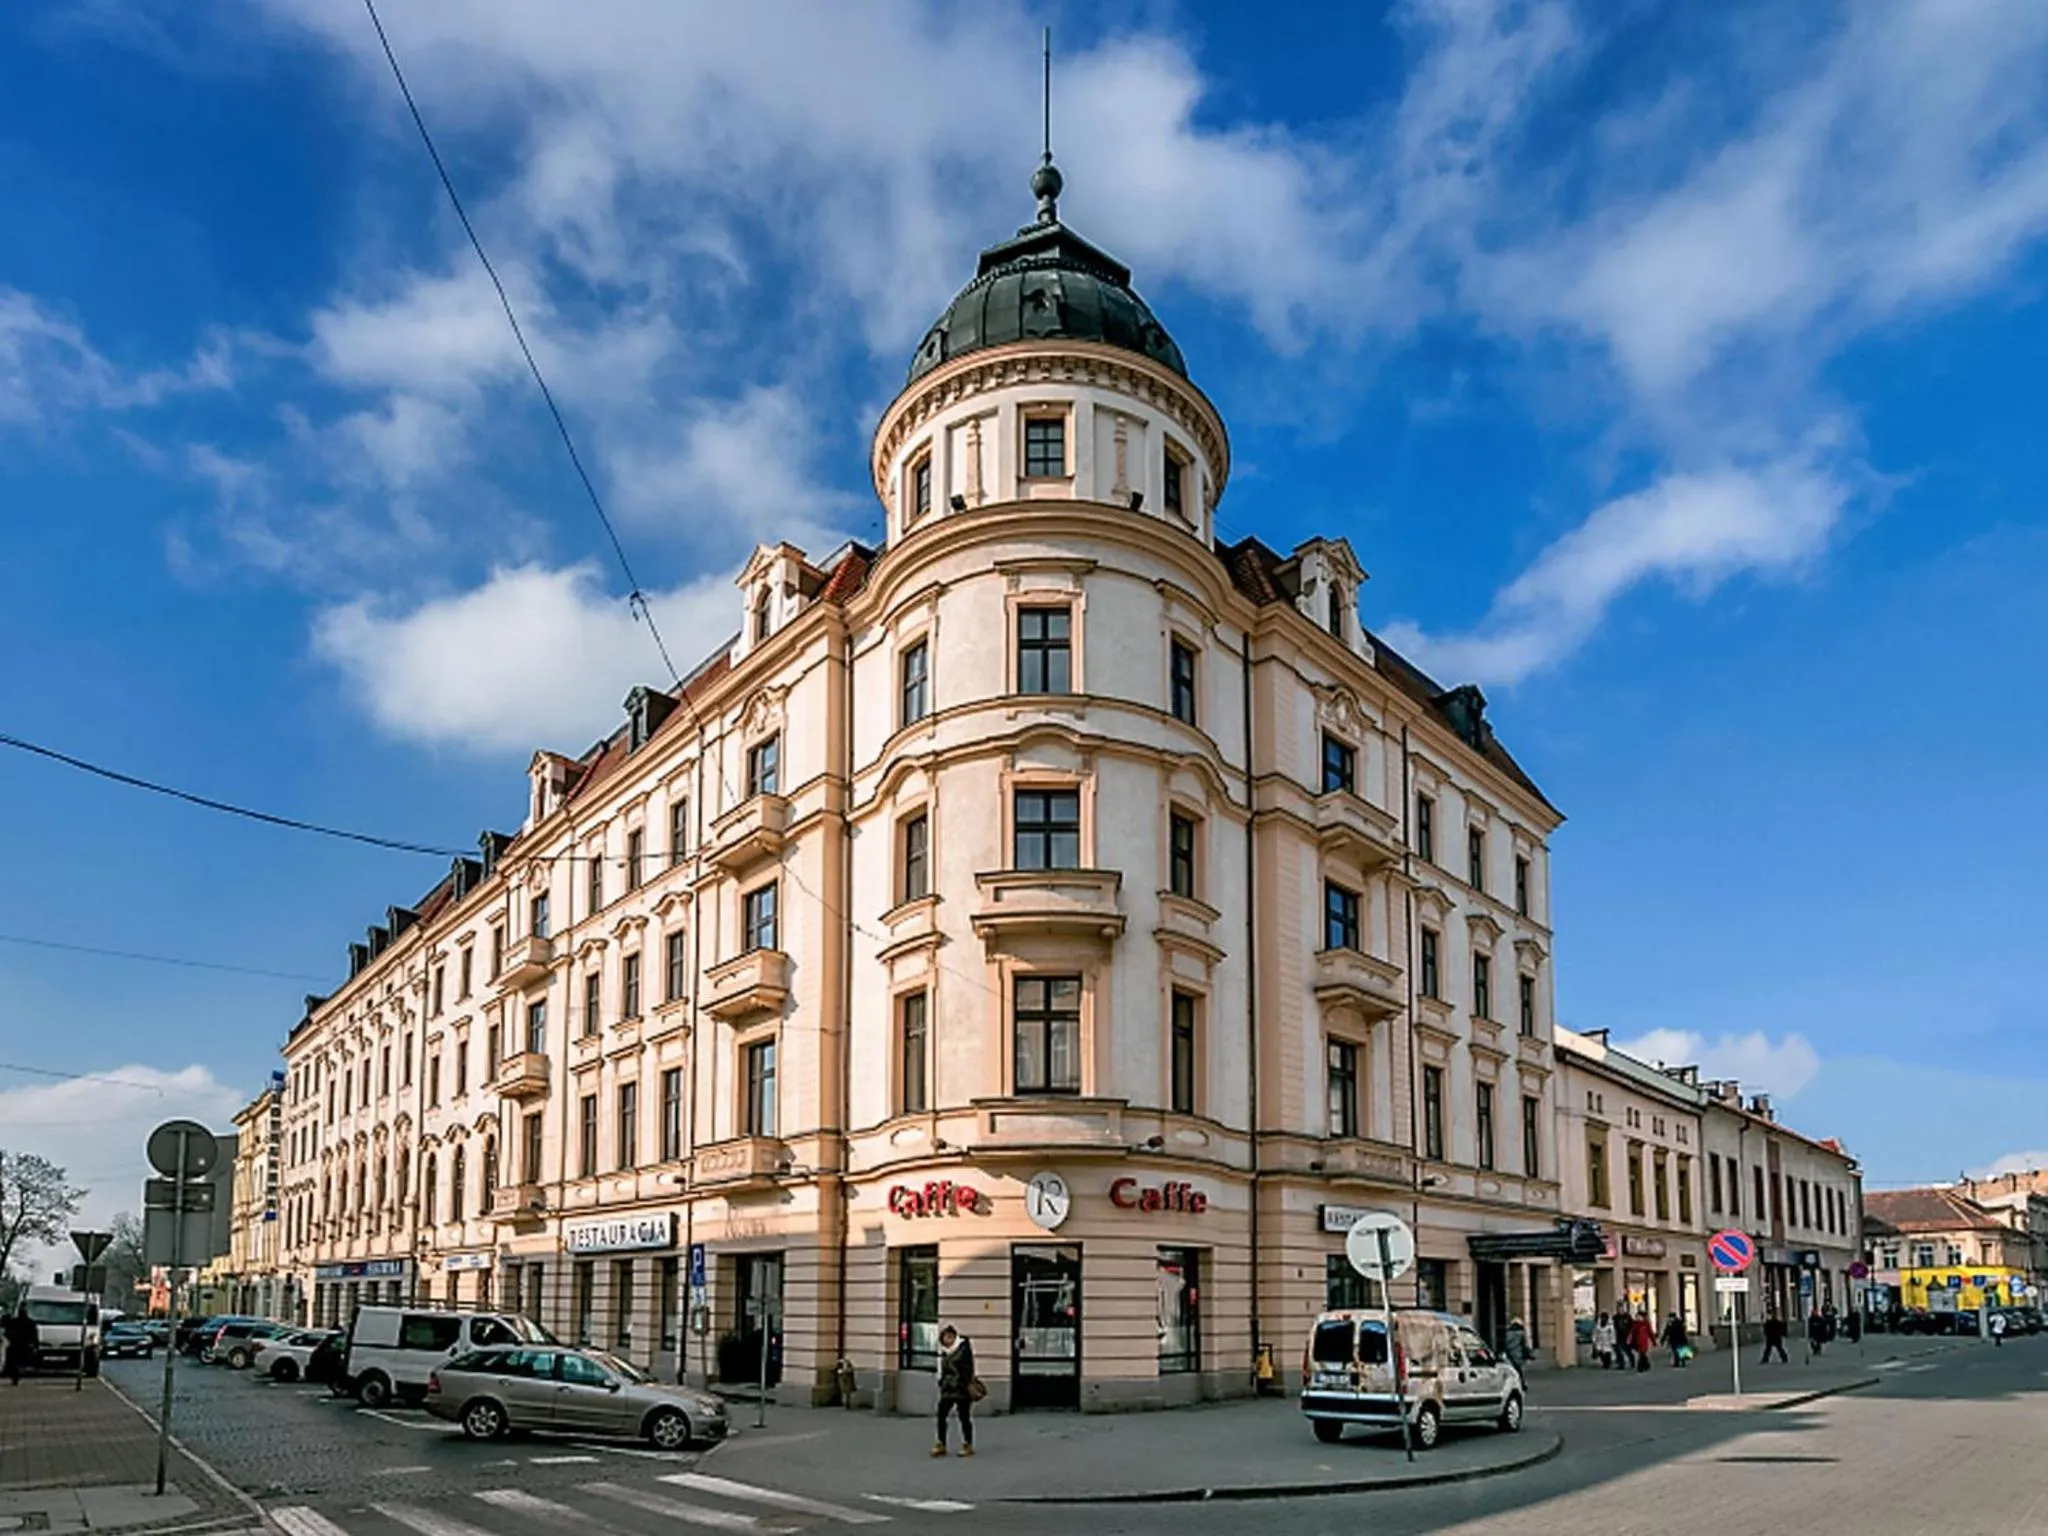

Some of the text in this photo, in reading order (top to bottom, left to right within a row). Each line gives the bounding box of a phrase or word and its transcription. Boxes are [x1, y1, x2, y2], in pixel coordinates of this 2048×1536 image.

[888, 1180, 978, 1214] Caffe
[1109, 1177, 1207, 1213] Caffe
[693, 1247, 703, 1273] P
